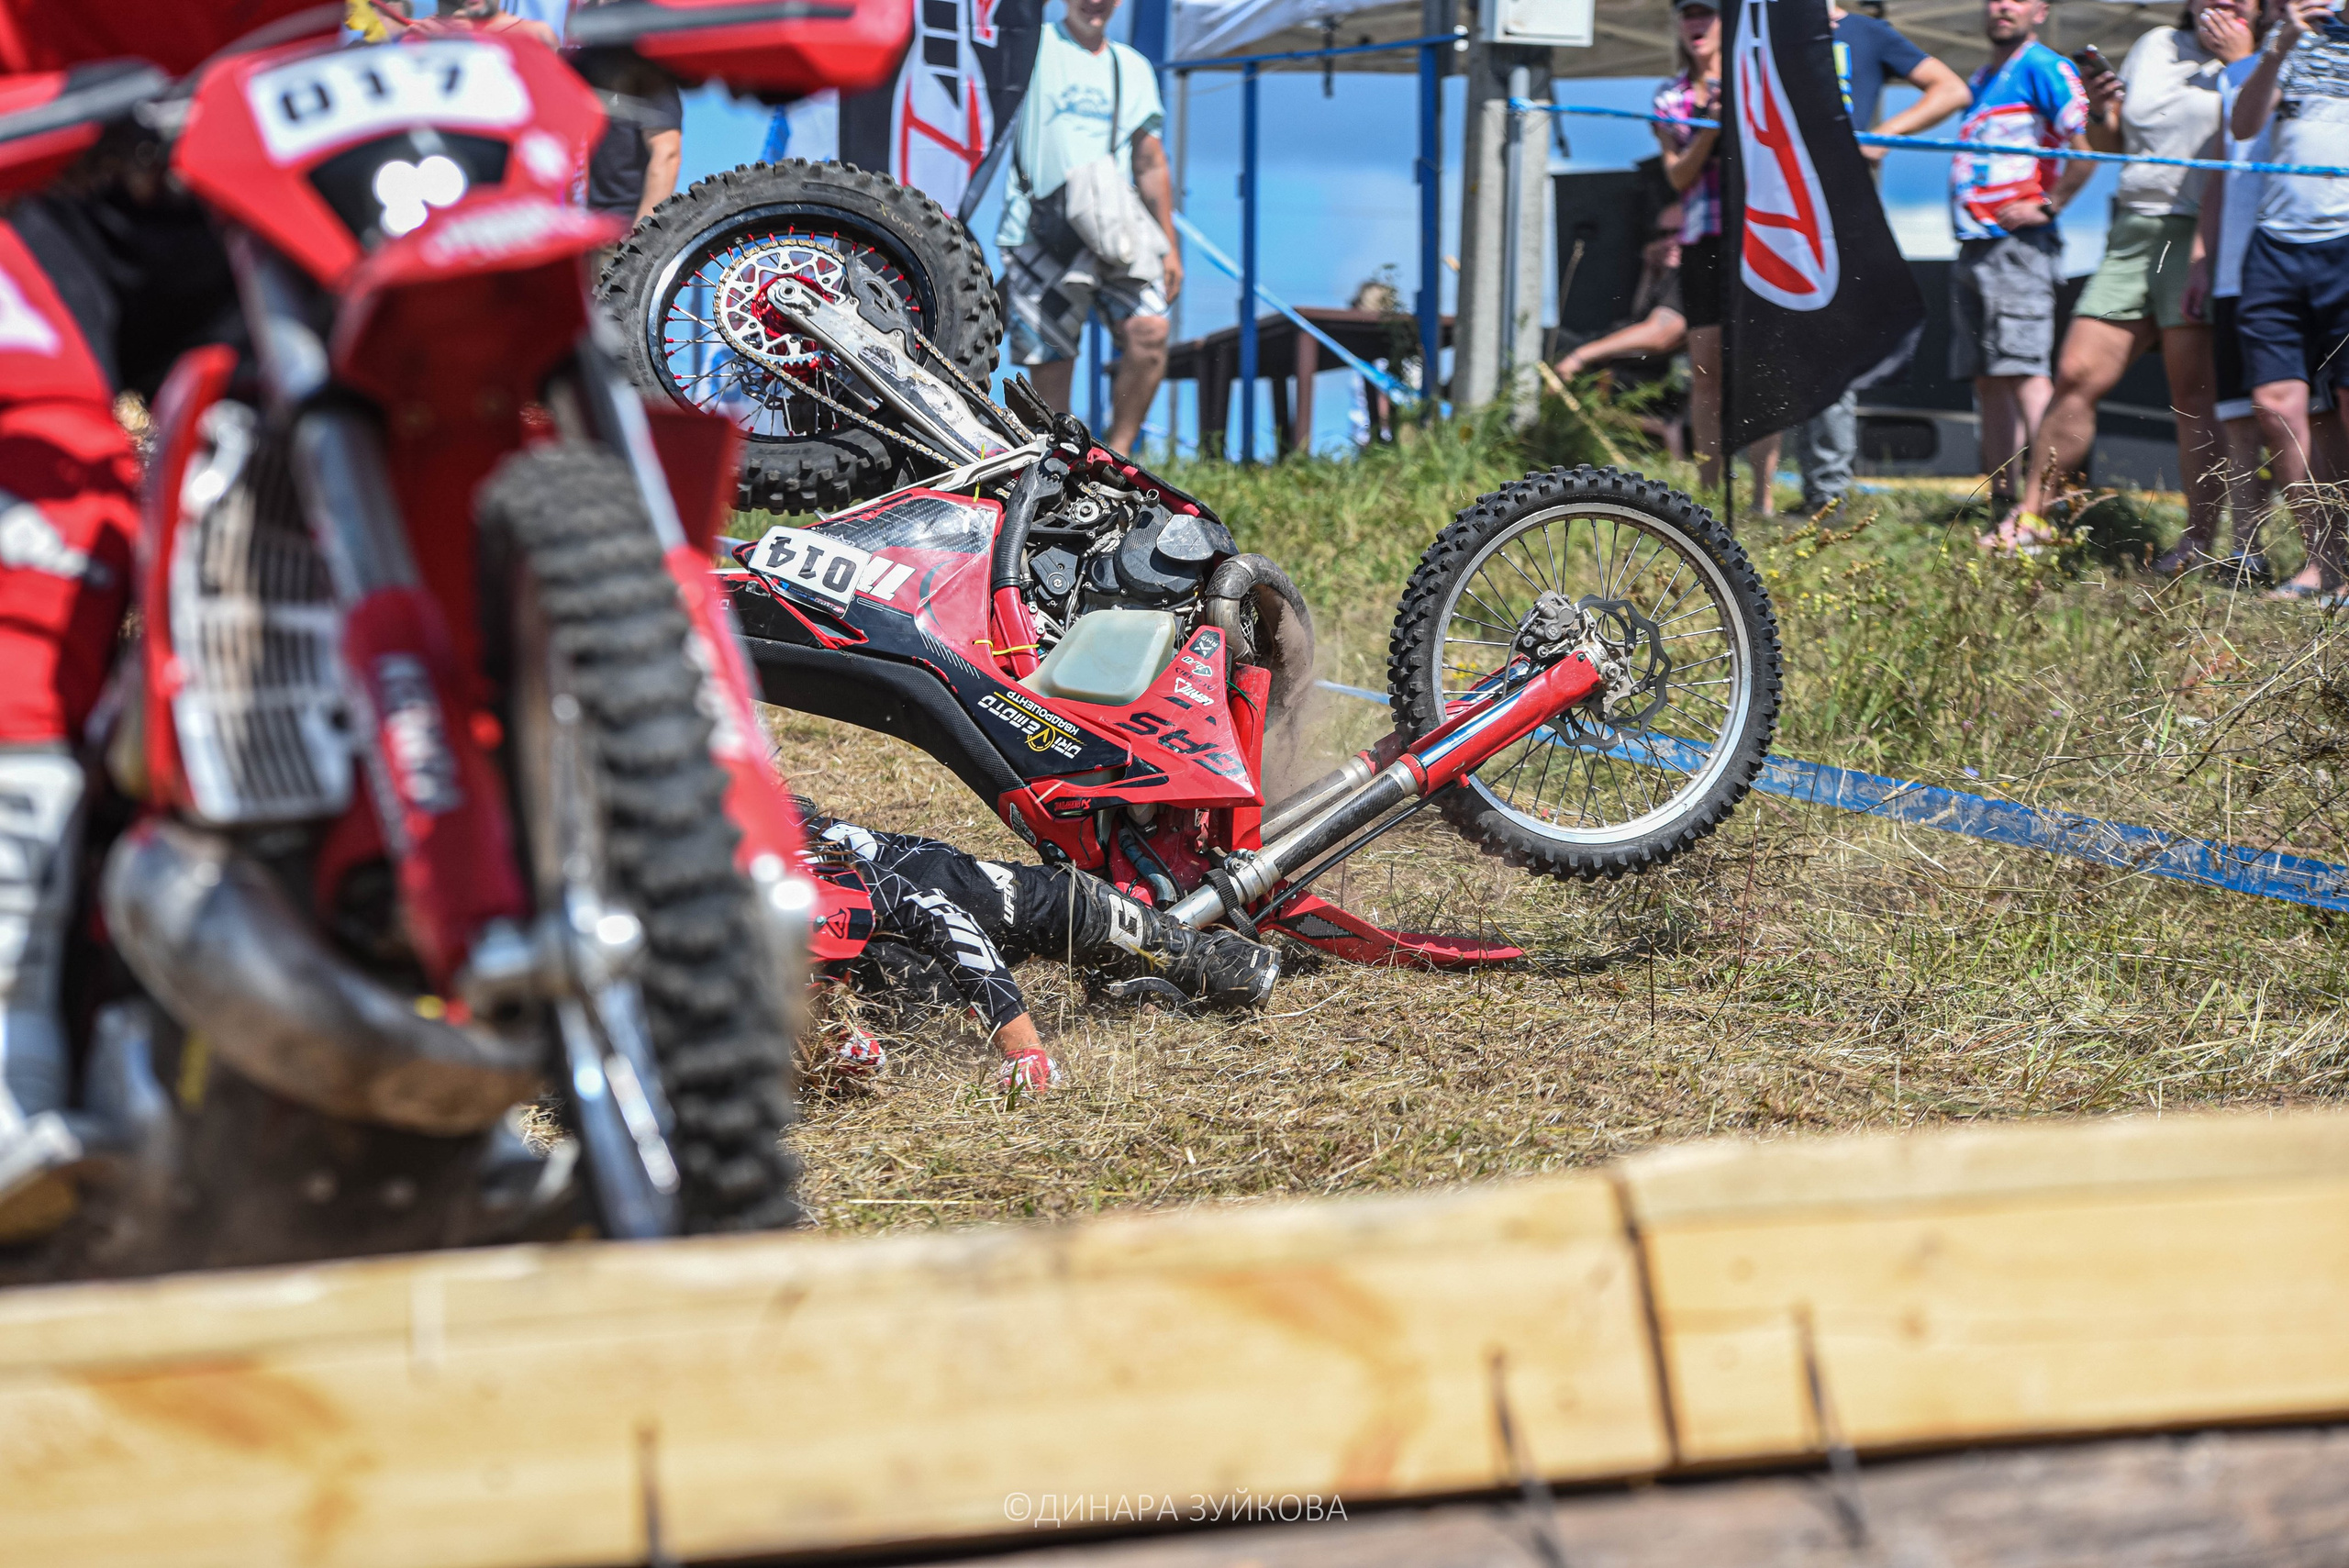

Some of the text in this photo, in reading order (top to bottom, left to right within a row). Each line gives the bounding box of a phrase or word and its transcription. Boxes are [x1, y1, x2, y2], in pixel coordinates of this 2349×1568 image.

[280, 57, 462, 123] 017
[766, 536, 857, 593] 014
[1006, 691, 1079, 735] КВАДРОЦЕНТР
[1003, 883, 1016, 926] UFO
